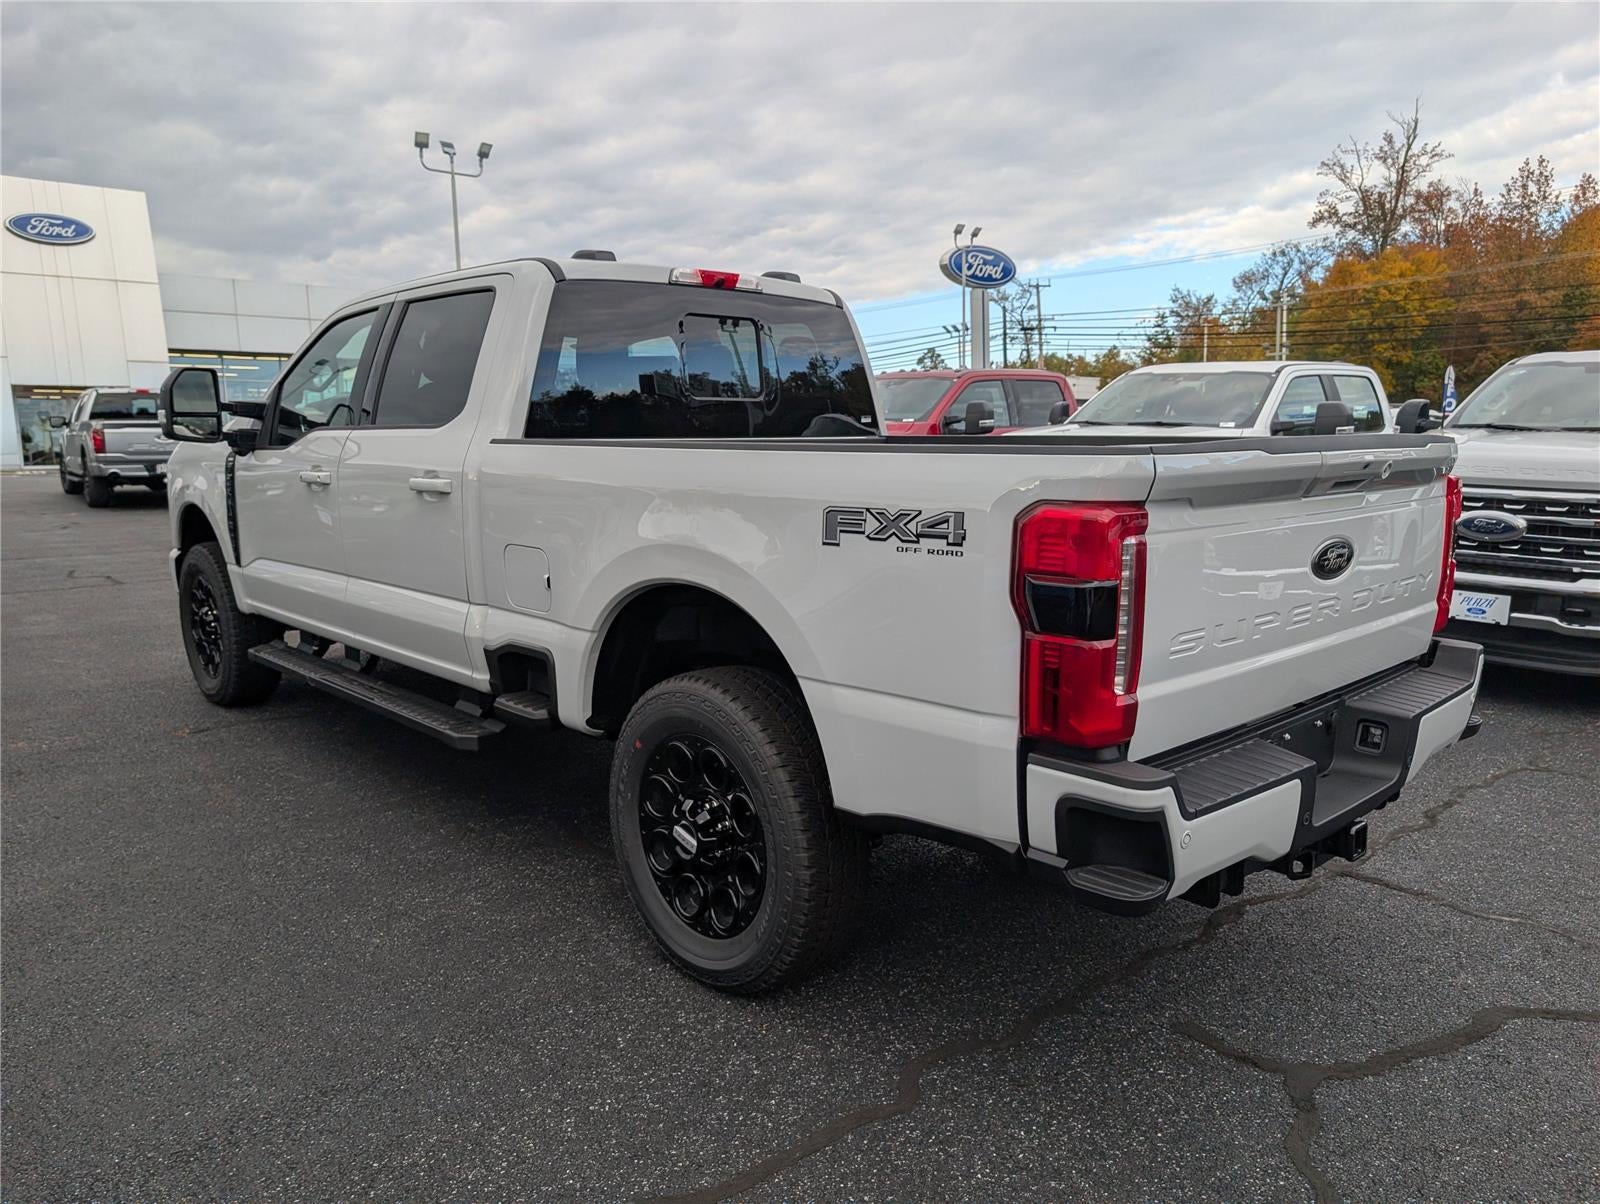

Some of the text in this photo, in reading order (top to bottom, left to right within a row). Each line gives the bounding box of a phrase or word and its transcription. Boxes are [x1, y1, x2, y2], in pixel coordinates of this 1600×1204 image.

[26, 217, 77, 238] Ford
[963, 251, 1004, 279] Ford
[822, 505, 966, 547] FX4
[1471, 518, 1505, 533] Ford
[896, 546, 964, 558] OFF ROAD
[1320, 547, 1349, 570] Ford
[1460, 596, 1497, 608] PLAZA
[1169, 570, 1434, 660] SUPER DUTY
